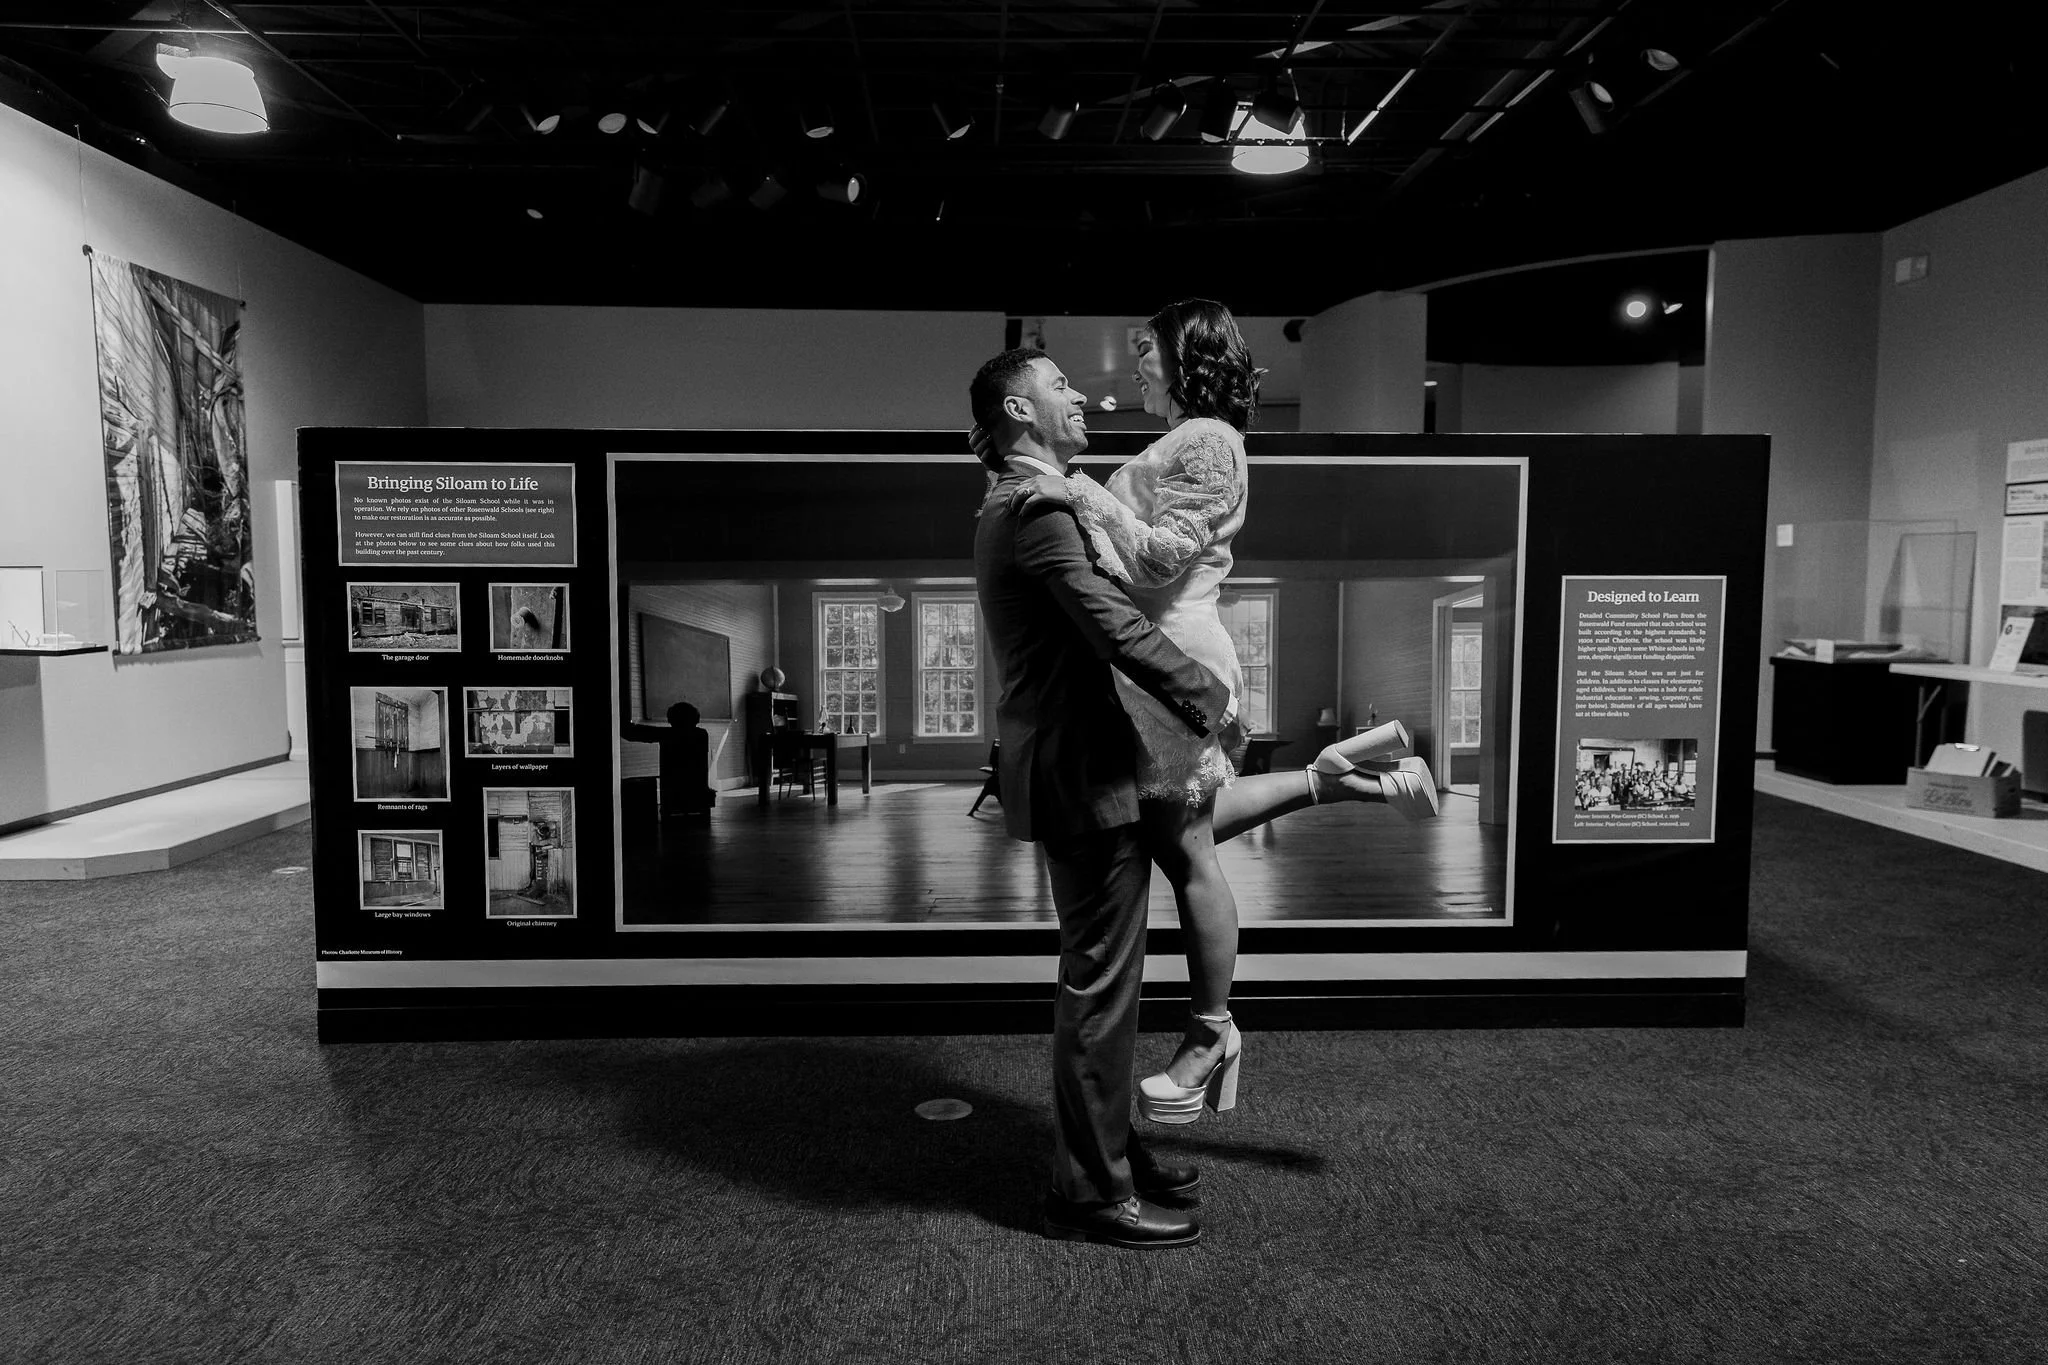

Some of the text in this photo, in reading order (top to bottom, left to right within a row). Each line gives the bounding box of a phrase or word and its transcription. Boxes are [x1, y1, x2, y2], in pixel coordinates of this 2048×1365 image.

[368, 476, 538, 492] Bringing Siloam to Life
[1587, 590, 1699, 605] Designed to Learn
